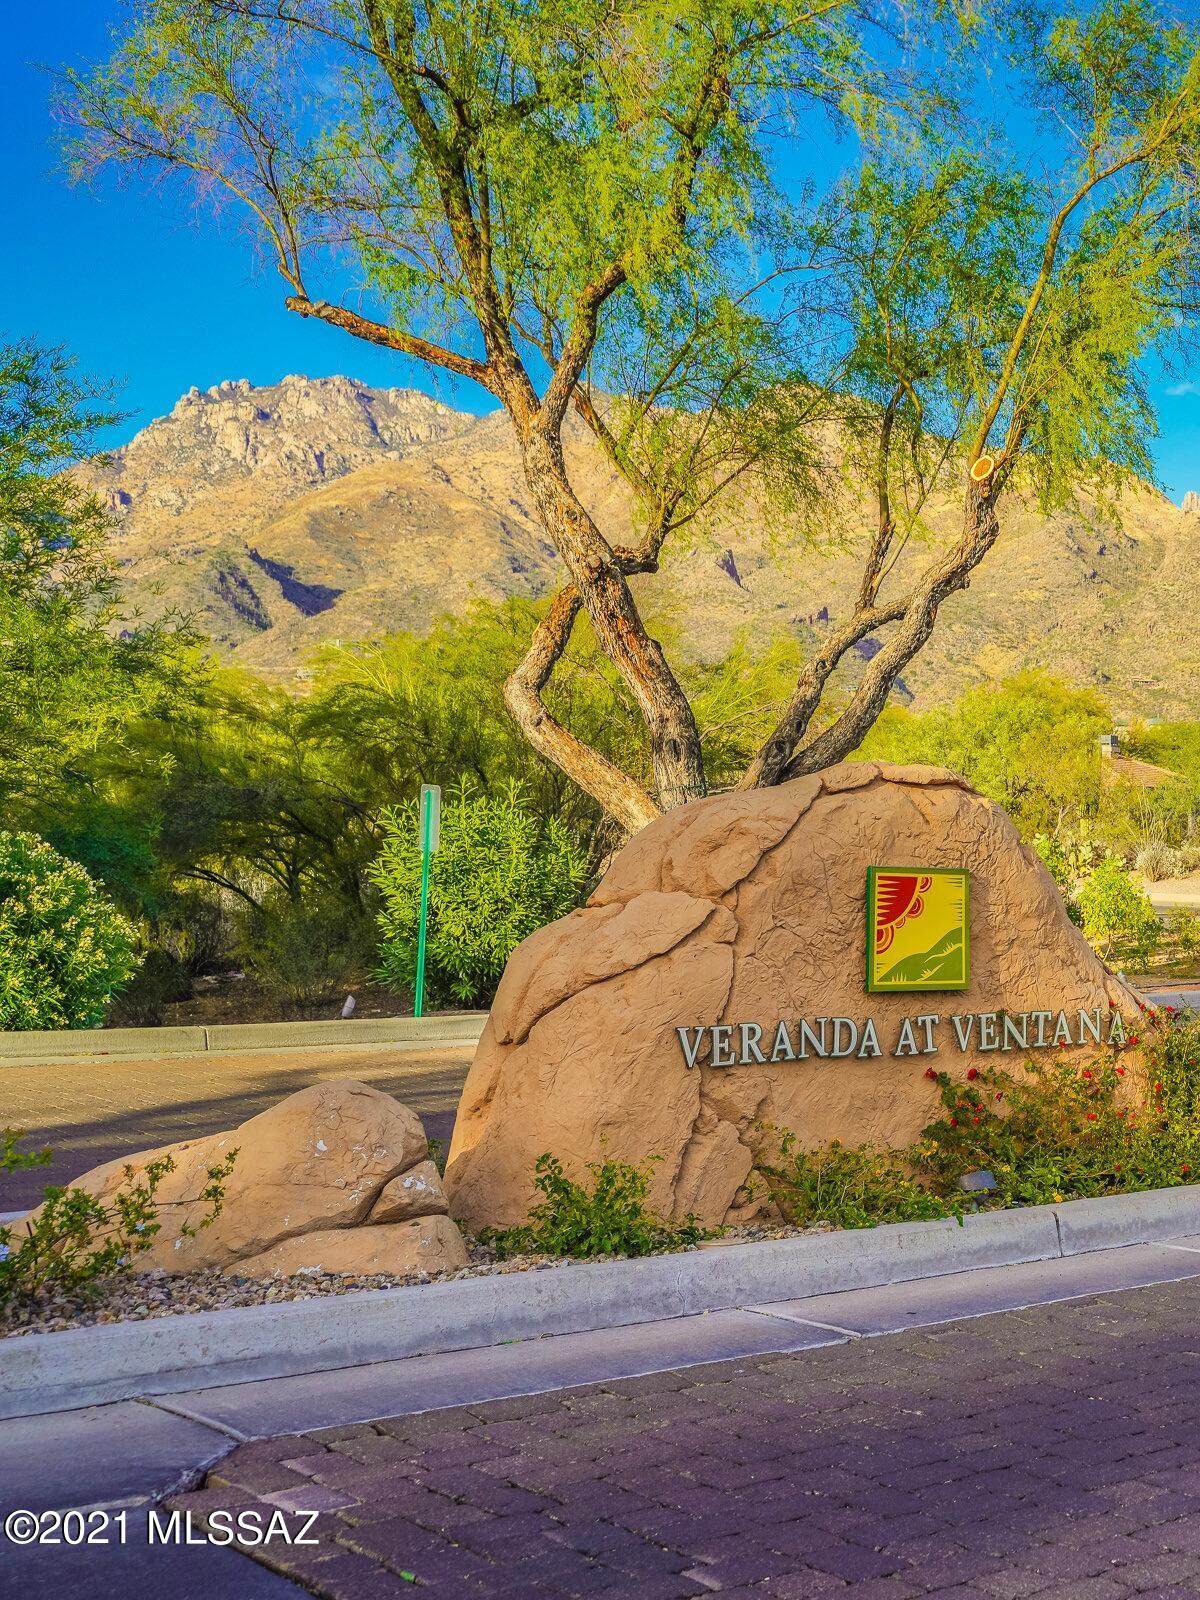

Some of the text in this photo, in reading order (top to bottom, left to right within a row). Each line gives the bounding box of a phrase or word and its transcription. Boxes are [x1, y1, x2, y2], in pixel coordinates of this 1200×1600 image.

[676, 1008, 1127, 1069] VERANDA AT VENTANA
